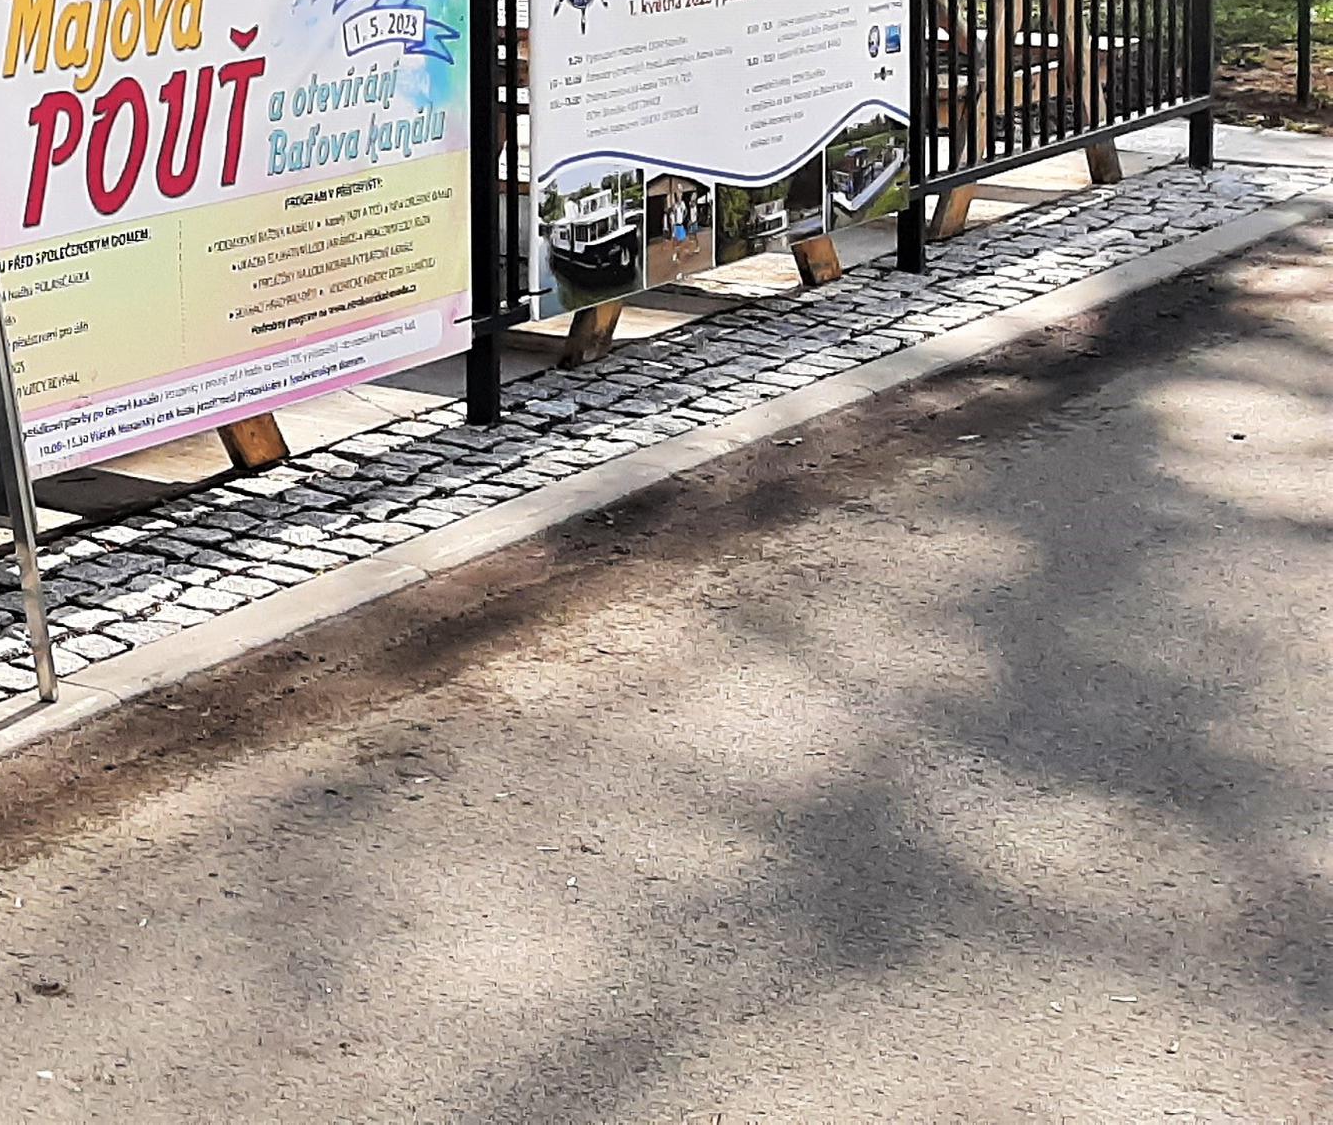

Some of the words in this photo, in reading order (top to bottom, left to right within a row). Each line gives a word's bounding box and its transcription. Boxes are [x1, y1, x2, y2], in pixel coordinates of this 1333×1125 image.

[22, 24, 267, 229] POUŤ
[268, 88, 284, 122] a
[291, 60, 401, 118] otevírání
[267, 124, 359, 176] Baťova
[366, 103, 446, 163] kanálu
